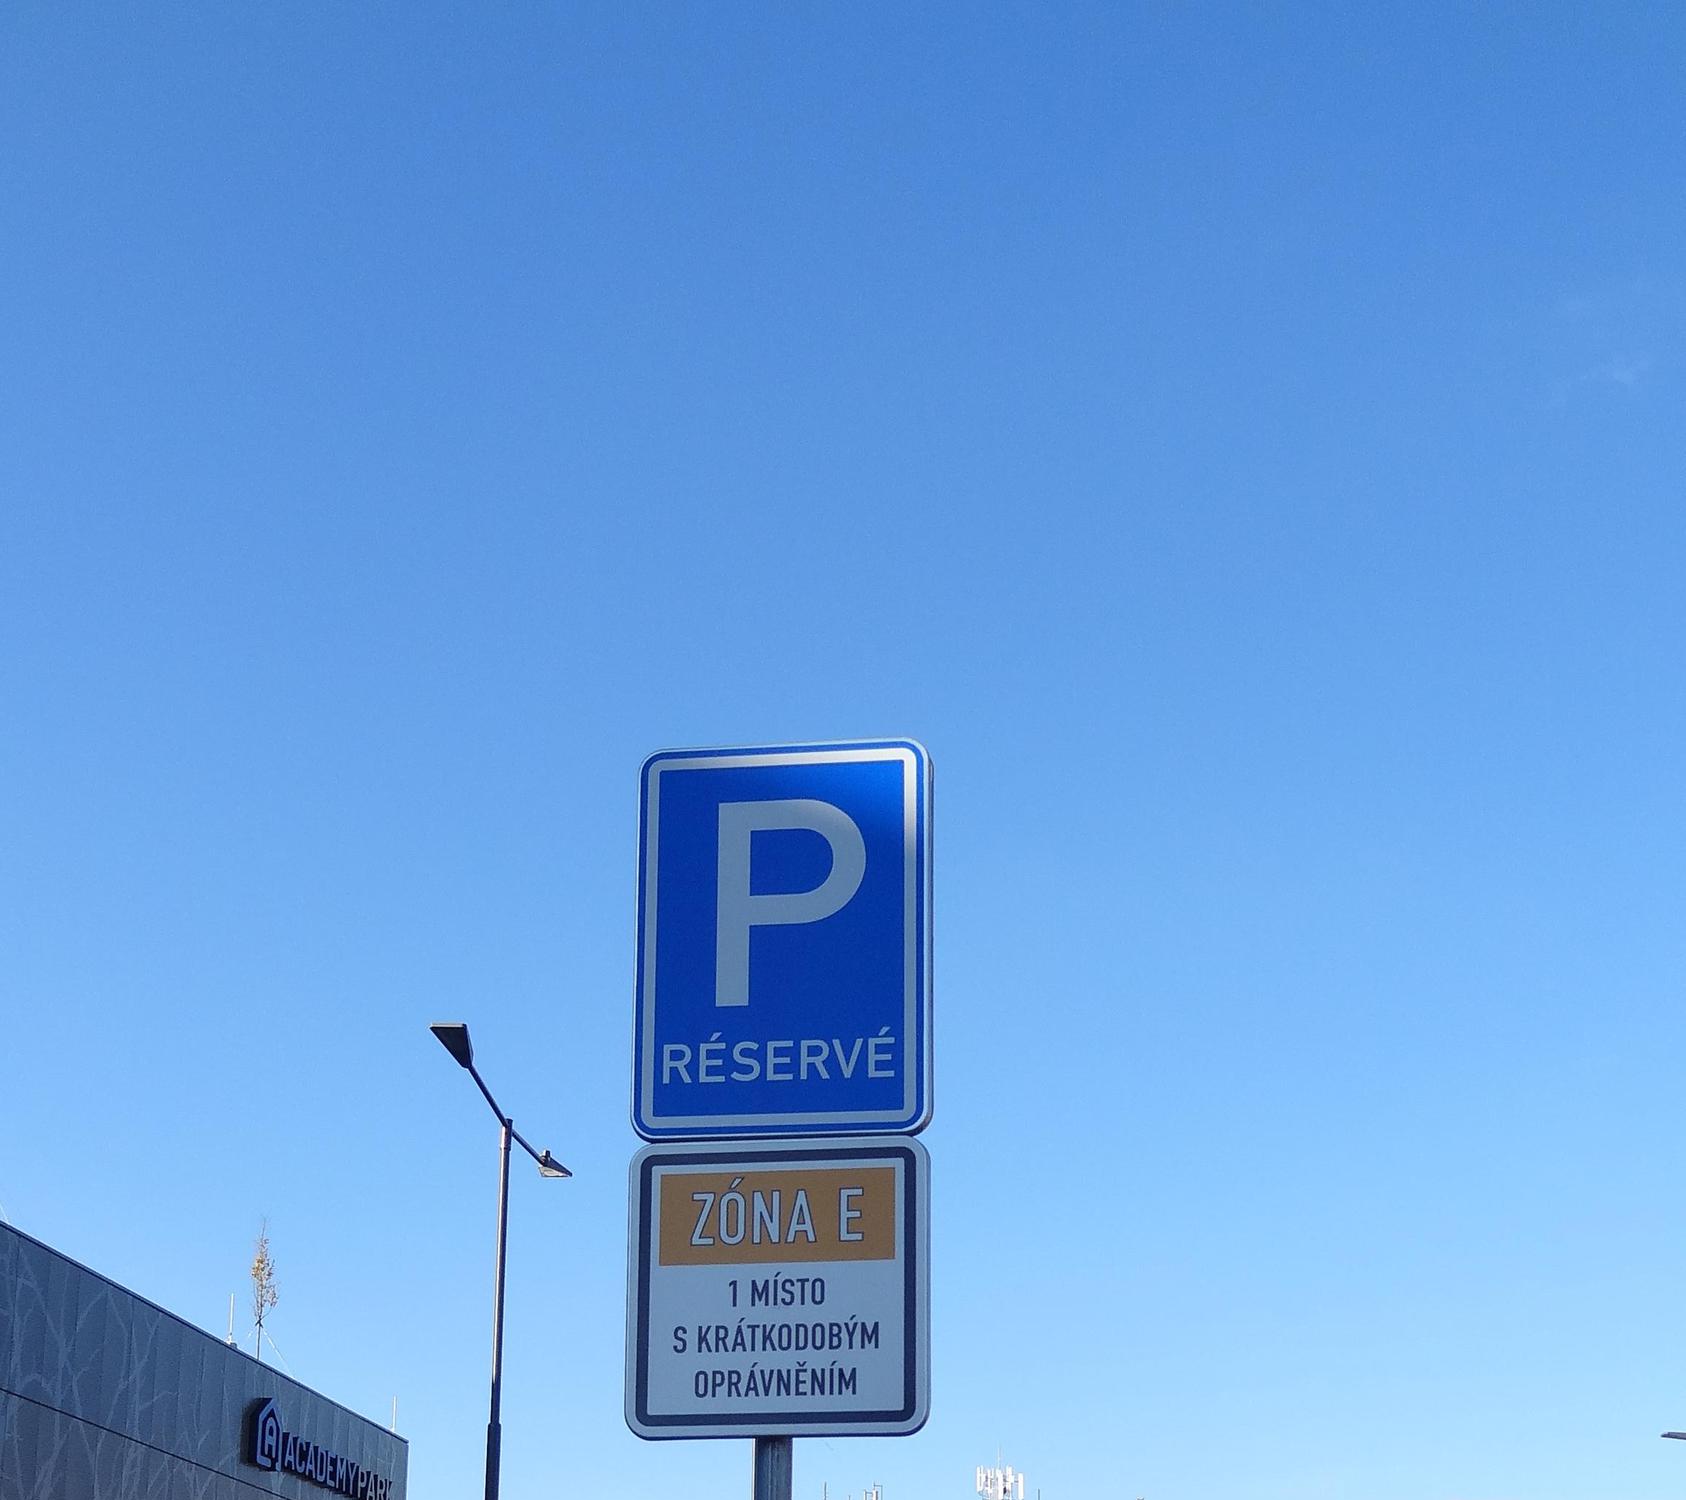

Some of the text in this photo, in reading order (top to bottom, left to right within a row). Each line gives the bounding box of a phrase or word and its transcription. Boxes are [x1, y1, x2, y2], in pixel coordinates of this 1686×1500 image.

[715, 799, 866, 1007] P
[662, 1026, 896, 1084] RÉSERVÉ
[690, 1176, 864, 1246] ZÓNA E
[728, 1272, 826, 1307] 1 MÍSTO
[672, 1314, 880, 1354] S KRÁTKODOBÝM
[694, 1361, 857, 1399] OPRÁVNĚNÍM
